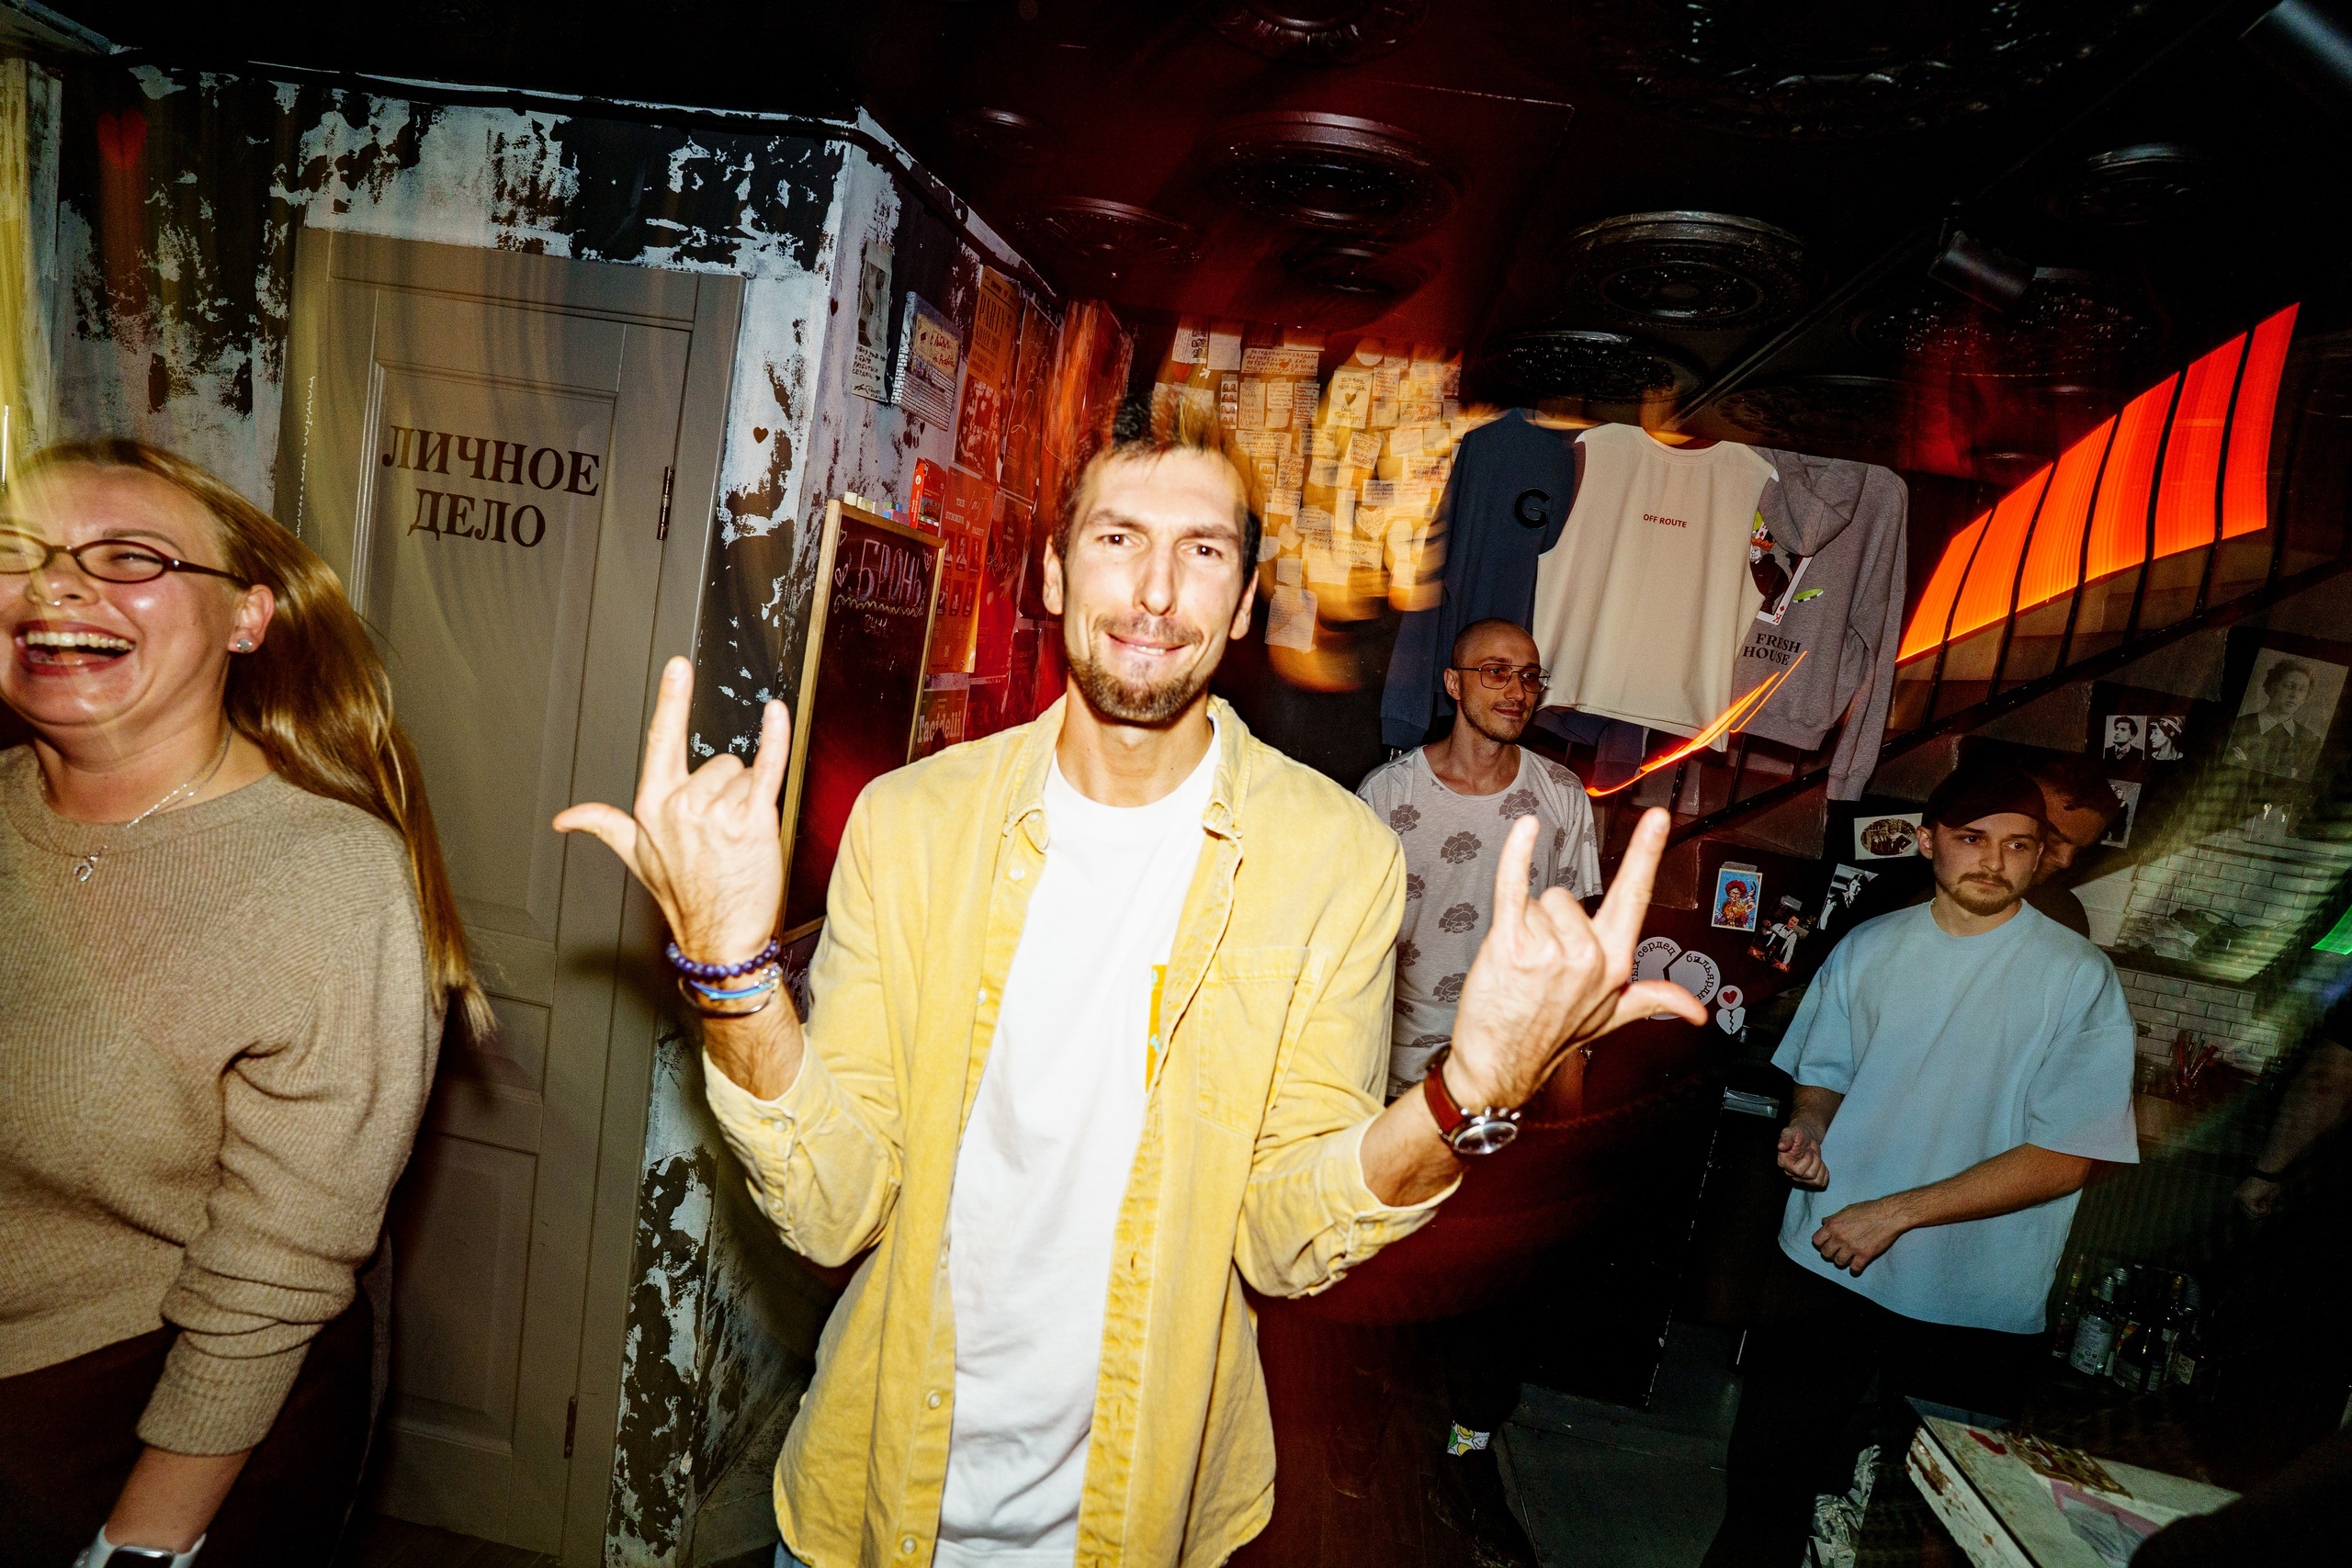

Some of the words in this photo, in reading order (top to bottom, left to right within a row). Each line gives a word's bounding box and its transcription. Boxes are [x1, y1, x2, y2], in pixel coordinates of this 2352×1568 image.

[978, 293, 1005, 337] PARTY
[381, 425, 600, 496] ЛИЧНОЕ
[407, 488, 546, 548] ДЕЛО
[956, 497, 966, 507] THE
[1513, 488, 1552, 529] G
[945, 511, 965, 525] SUMMER
[971, 525, 985, 536] PARTY
[1644, 513, 1657, 523] OFF
[1659, 517, 1687, 527] ROUTE
[857, 538, 922, 606] БРОНЬ
[1743, 646, 1791, 666] HOUSE
[1755, 633, 1801, 653] FRESH
[1637, 941, 1677, 958] сердец
[1686, 953, 1715, 1000] бильярдн
